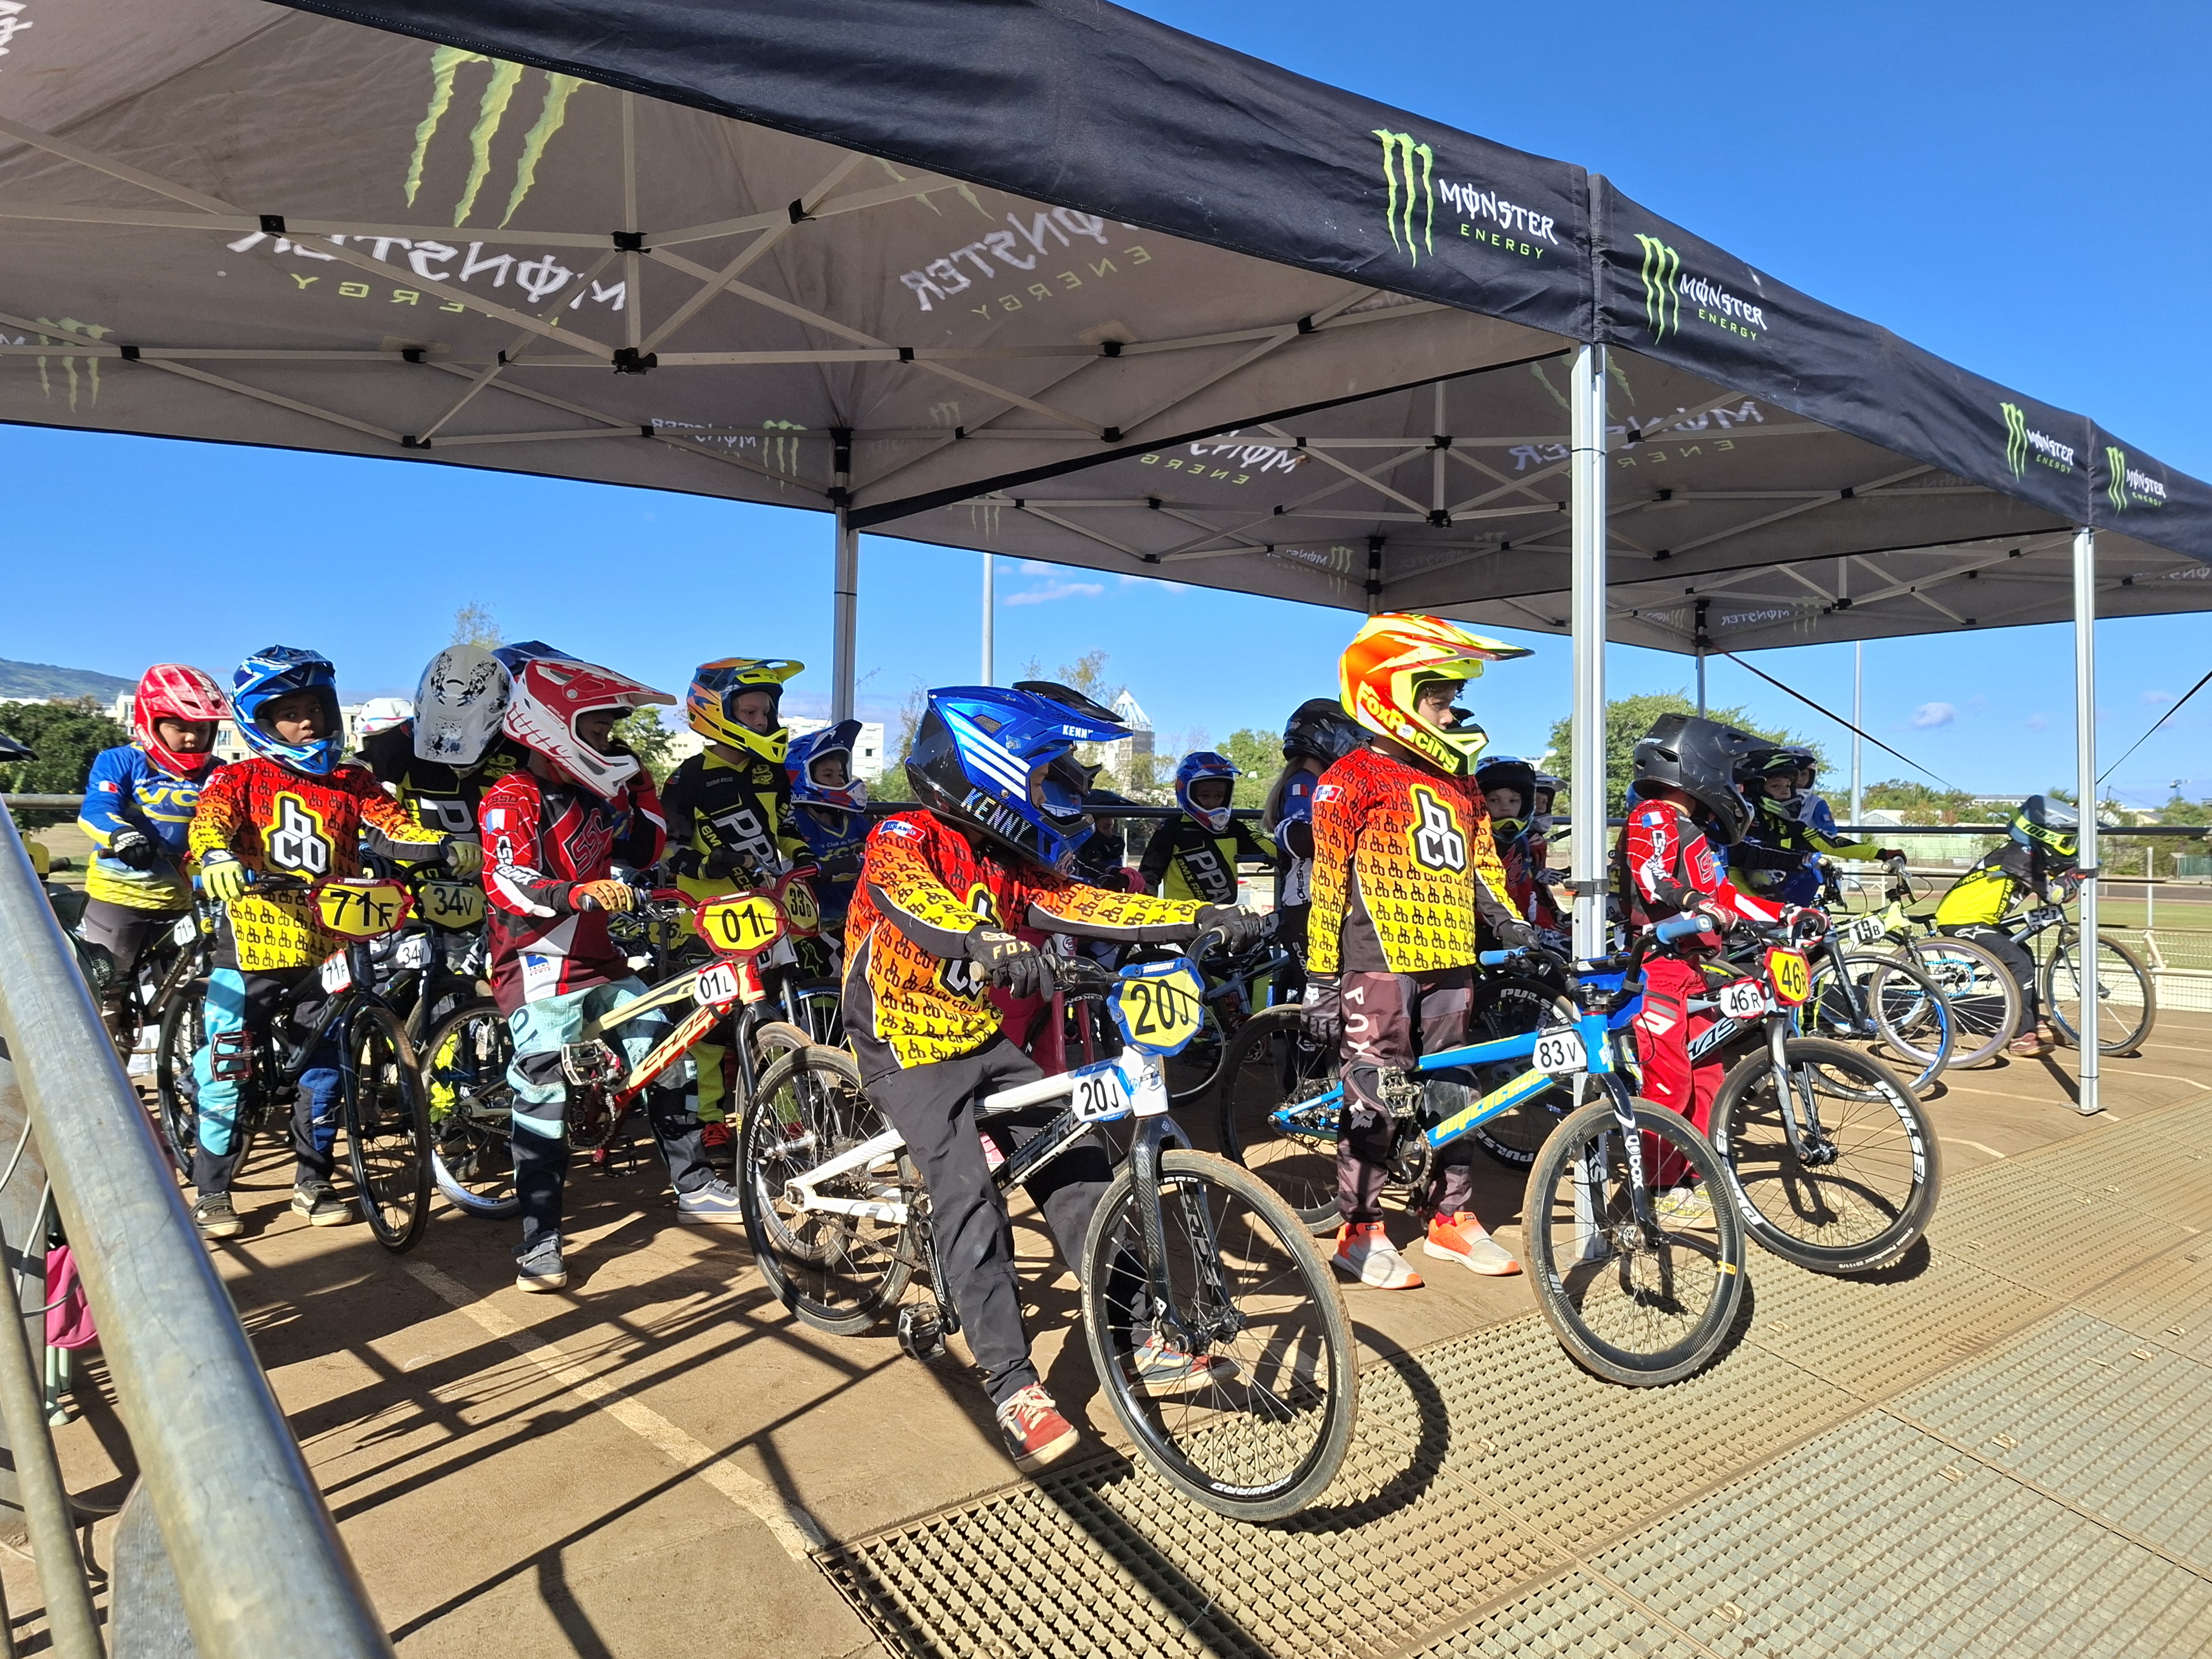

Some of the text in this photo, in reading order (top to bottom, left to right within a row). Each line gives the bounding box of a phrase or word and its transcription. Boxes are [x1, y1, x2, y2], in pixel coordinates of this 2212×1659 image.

[1460, 223, 1544, 259] ENERGY
[1699, 309, 1757, 341] ENERGY
[2036, 454, 2072, 474] ENERGY
[961, 788, 1032, 842] KENNY
[2022, 822, 2060, 843] 100%
[1177, 859, 1193, 883] BMX
[330, 891, 394, 927] 71F
[722, 904, 774, 943] 01L
[993, 942, 1031, 960] FOX
[1142, 962, 1176, 974] TANGENT
[1781, 959, 1808, 995] 46R
[700, 972, 732, 1000] 01L
[1730, 989, 1761, 1014] 46R
[1130, 979, 1190, 1036] 20J
[1539, 1040, 1576, 1068] 83V
[1080, 1078, 1119, 1116] 20J
[746, 1102, 765, 1185] FORWARD
[1873, 1080, 1925, 1177] PULSE
[924, 1244, 945, 1302] FORWARD
[1083, 1282, 1089, 1293] X
[1210, 1472, 1293, 1495] FORWARD
